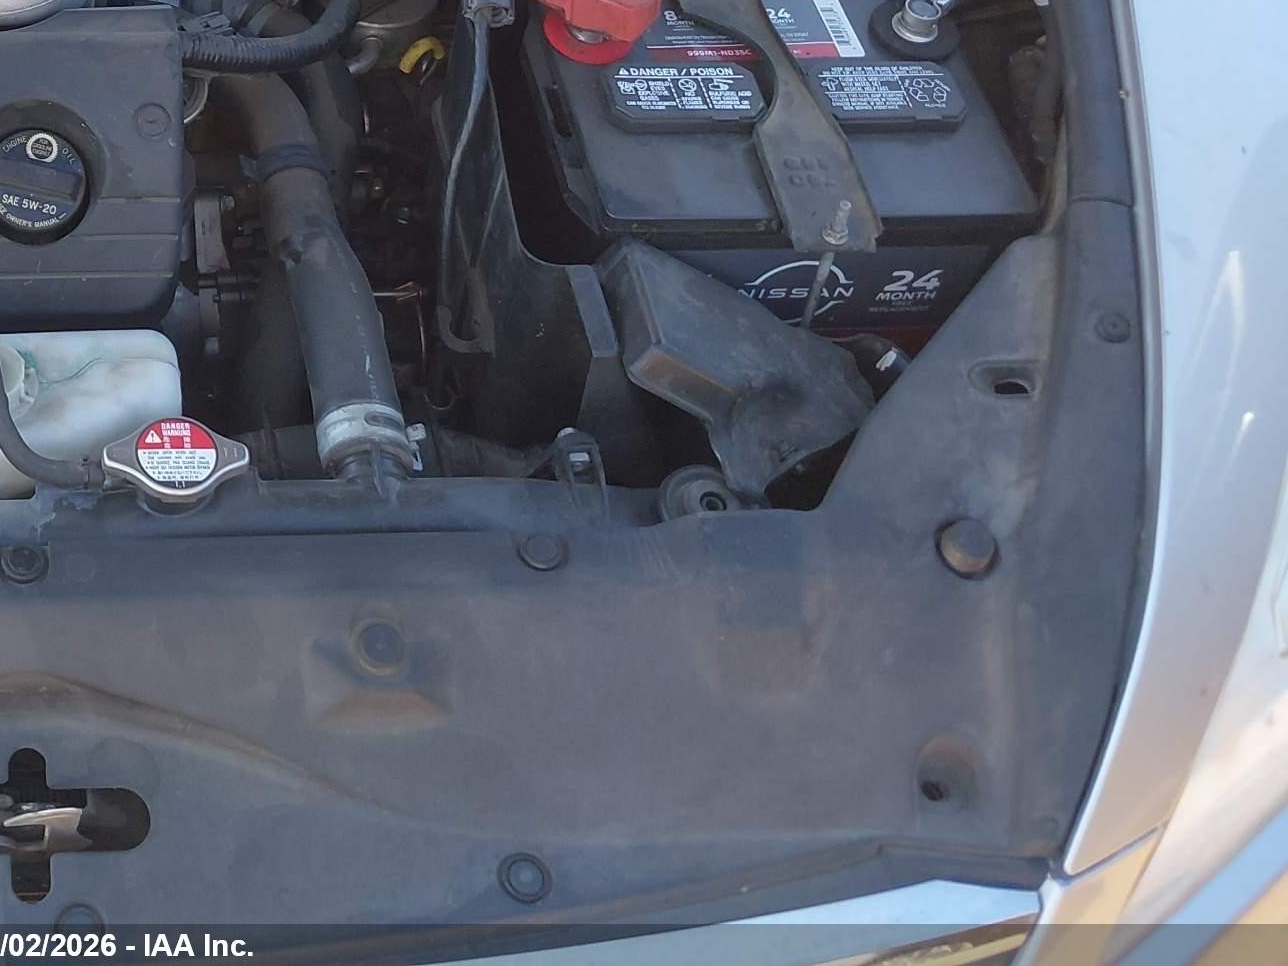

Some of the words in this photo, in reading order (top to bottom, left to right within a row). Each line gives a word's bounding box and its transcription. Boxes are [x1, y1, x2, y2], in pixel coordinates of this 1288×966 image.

[766, 8, 792, 19] 24
[629, 68, 678, 76] DANGER
[689, 67, 734, 75] POISON
[2, 137, 28, 153] ENGINE
[62, 147, 76, 164] OIL
[1, 194, 20, 206] SAE
[21, 198, 57, 215] 5W-20
[34, 217, 60, 228] MANUAL
[883, 269, 944, 292] 24
[875, 291, 937, 301] MONTH
